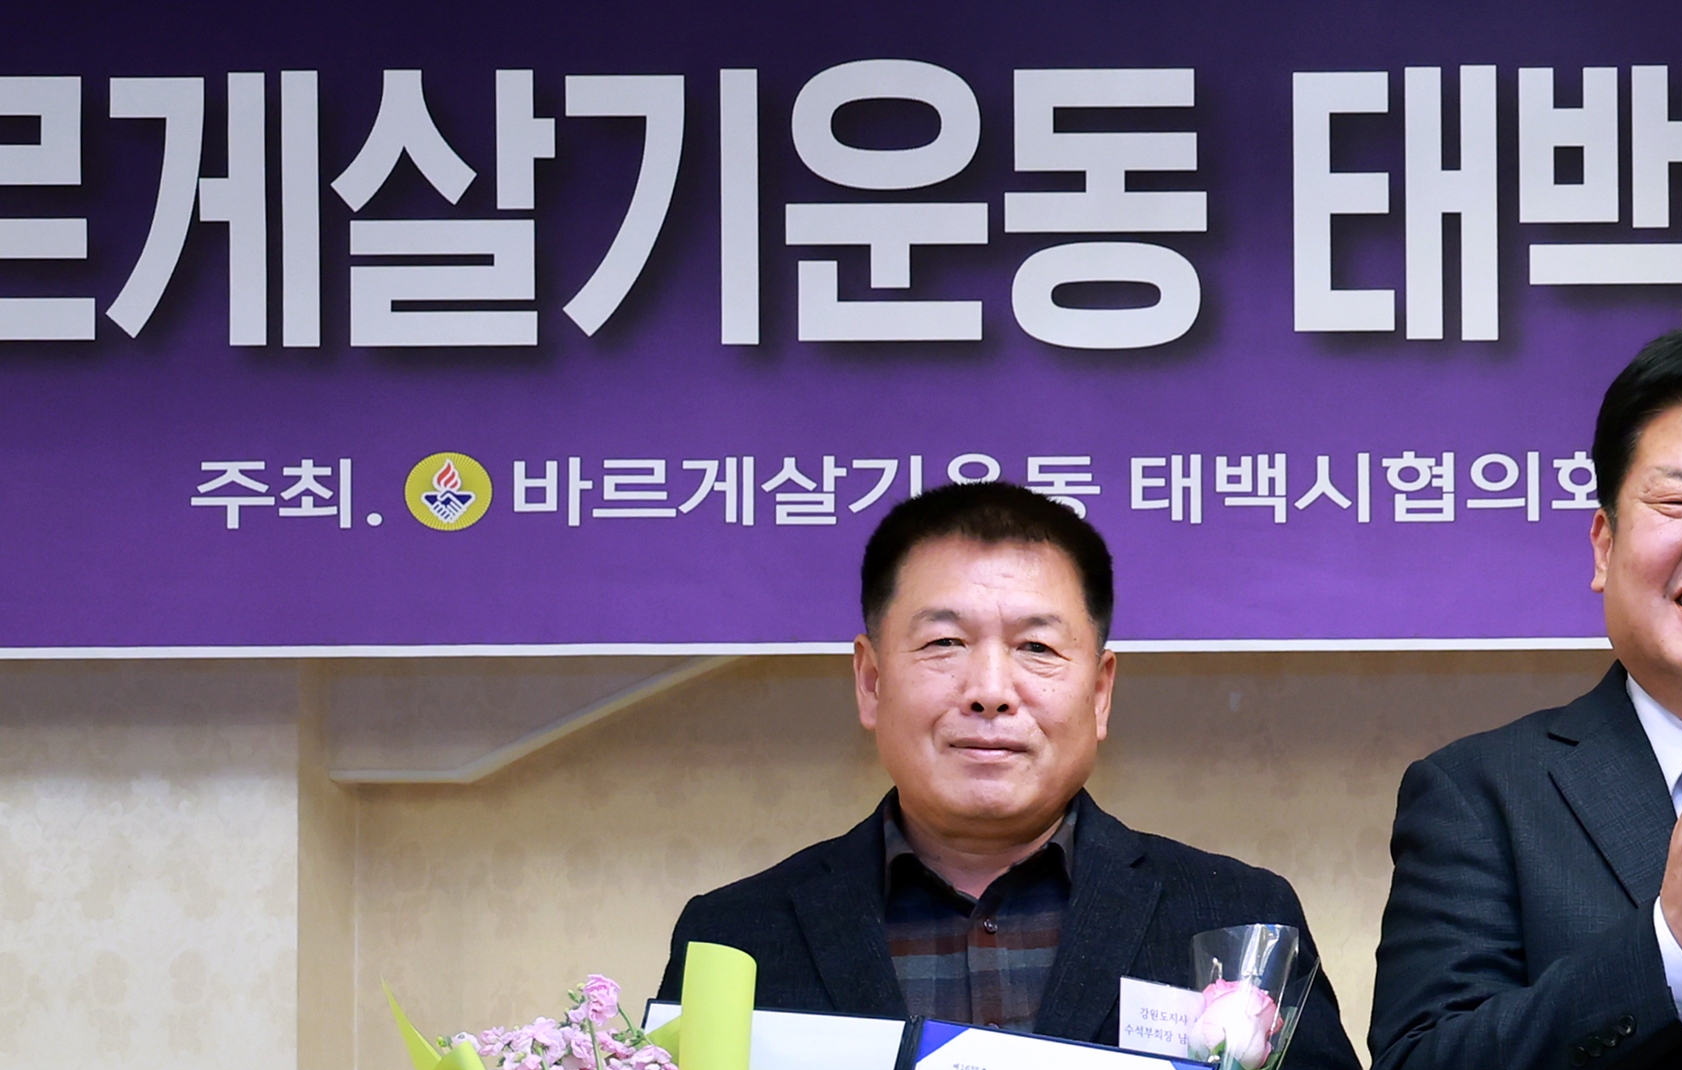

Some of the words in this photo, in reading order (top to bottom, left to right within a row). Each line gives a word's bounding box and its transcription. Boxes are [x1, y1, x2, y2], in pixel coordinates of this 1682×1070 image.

[189, 459, 383, 530] 주최.
[1139, 1007, 1188, 1026] 강원도지사
[1124, 1024, 1173, 1042] 수석부회장
